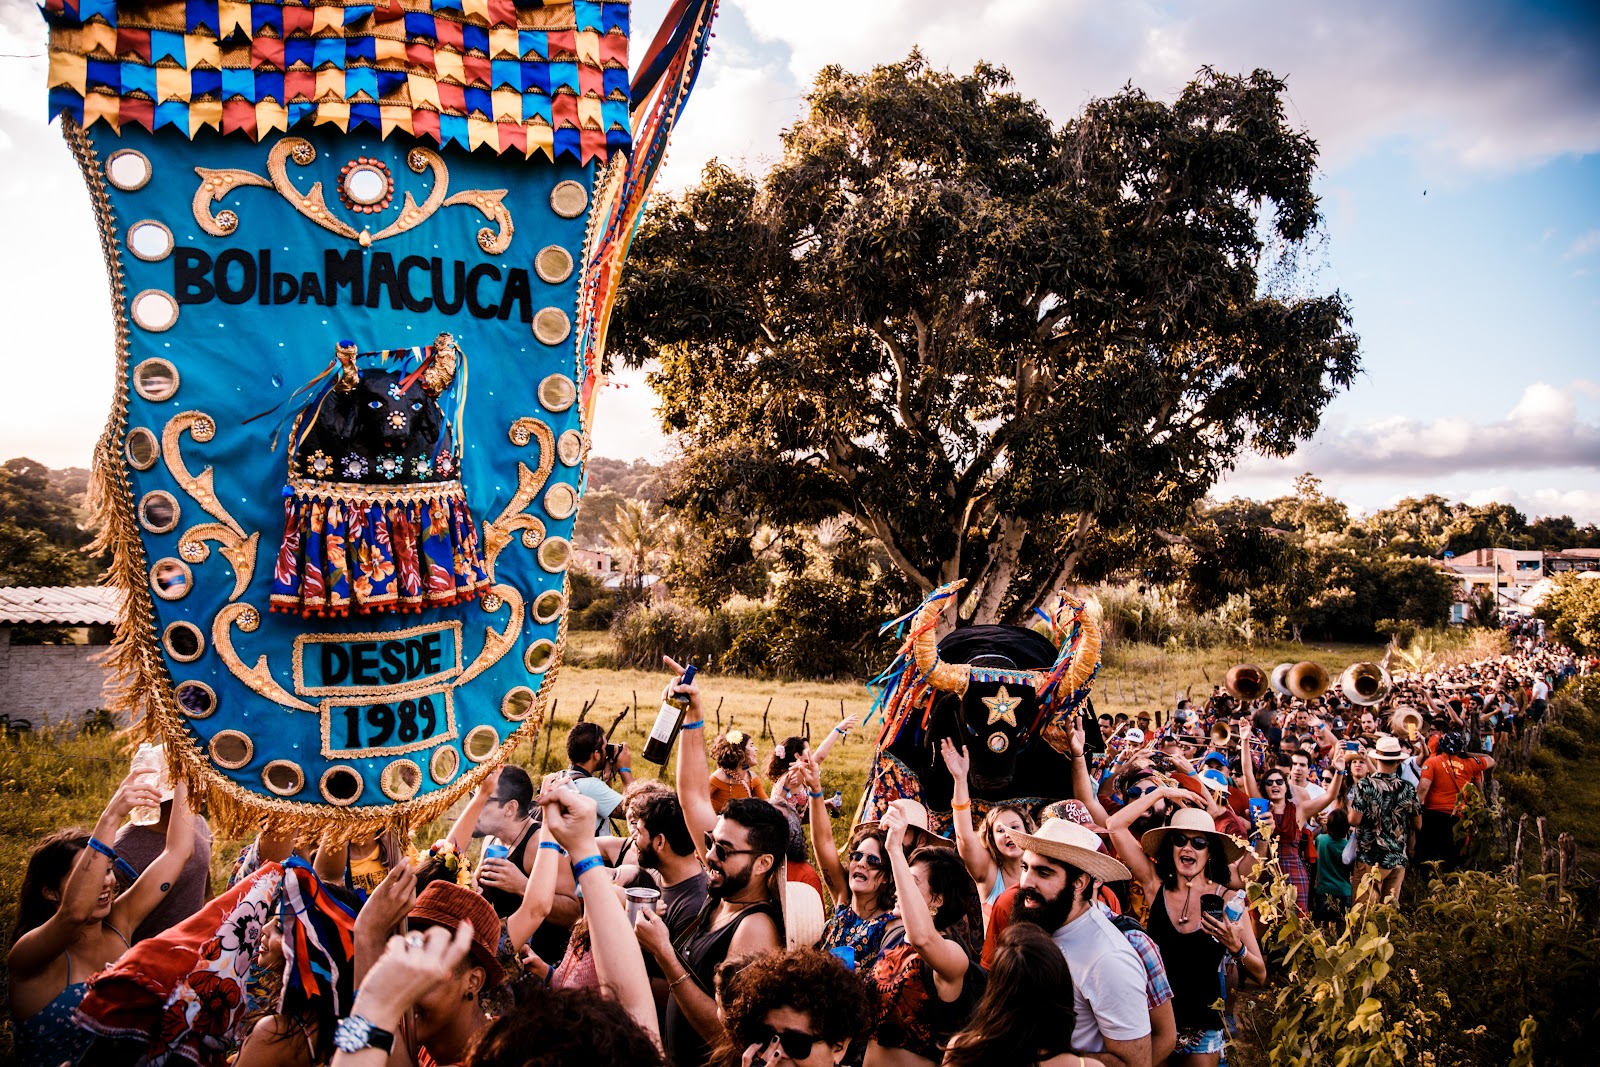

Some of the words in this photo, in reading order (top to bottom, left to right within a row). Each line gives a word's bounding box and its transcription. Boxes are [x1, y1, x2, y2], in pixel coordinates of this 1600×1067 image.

[174, 247, 271, 305] BOI
[324, 249, 533, 323] MACUCA
[321, 633, 441, 686] DESDE
[343, 695, 436, 748] 1989
